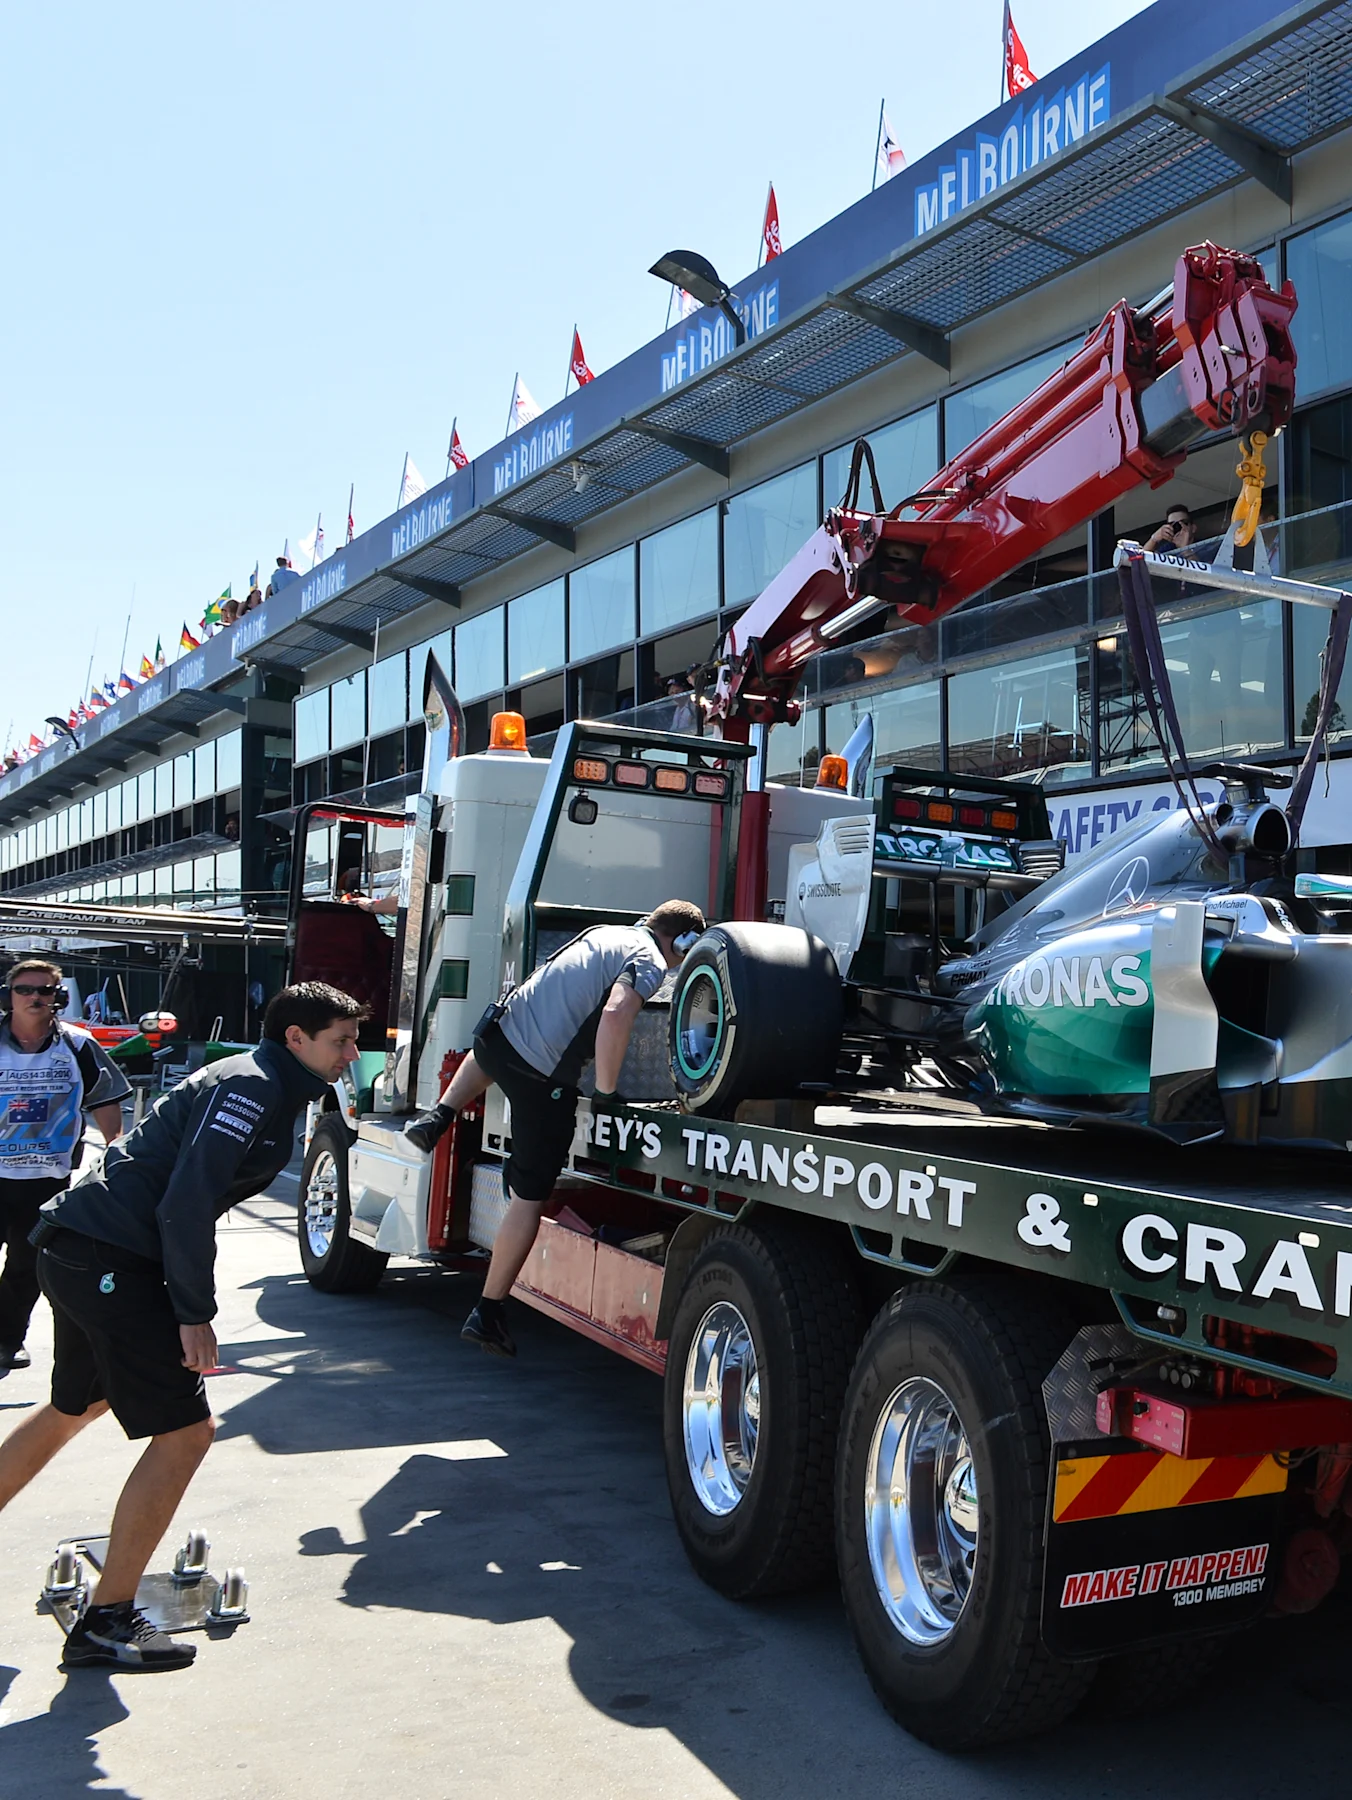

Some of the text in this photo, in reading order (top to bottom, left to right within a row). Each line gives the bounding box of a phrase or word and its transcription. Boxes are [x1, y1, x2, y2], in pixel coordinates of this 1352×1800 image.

[908, 73, 1106, 238] MELBOURNE
[17, 909, 95, 923] CATERHAM
[110, 916, 147, 926] TEAM
[45, 927, 79, 935] TEAM
[221, 1100, 261, 1121] SWISSQUOTE
[227, 1092, 265, 1114] PETRONAS
[215, 1111, 254, 1135] PIRELLI
[682, 1128, 977, 1227] TRANSPORT
[1016, 1192, 1072, 1253] &
[1060, 1543, 1270, 1608] MAKE IT HAPPEN!
[1172, 1577, 1267, 1607] 1300 MEMBREY
